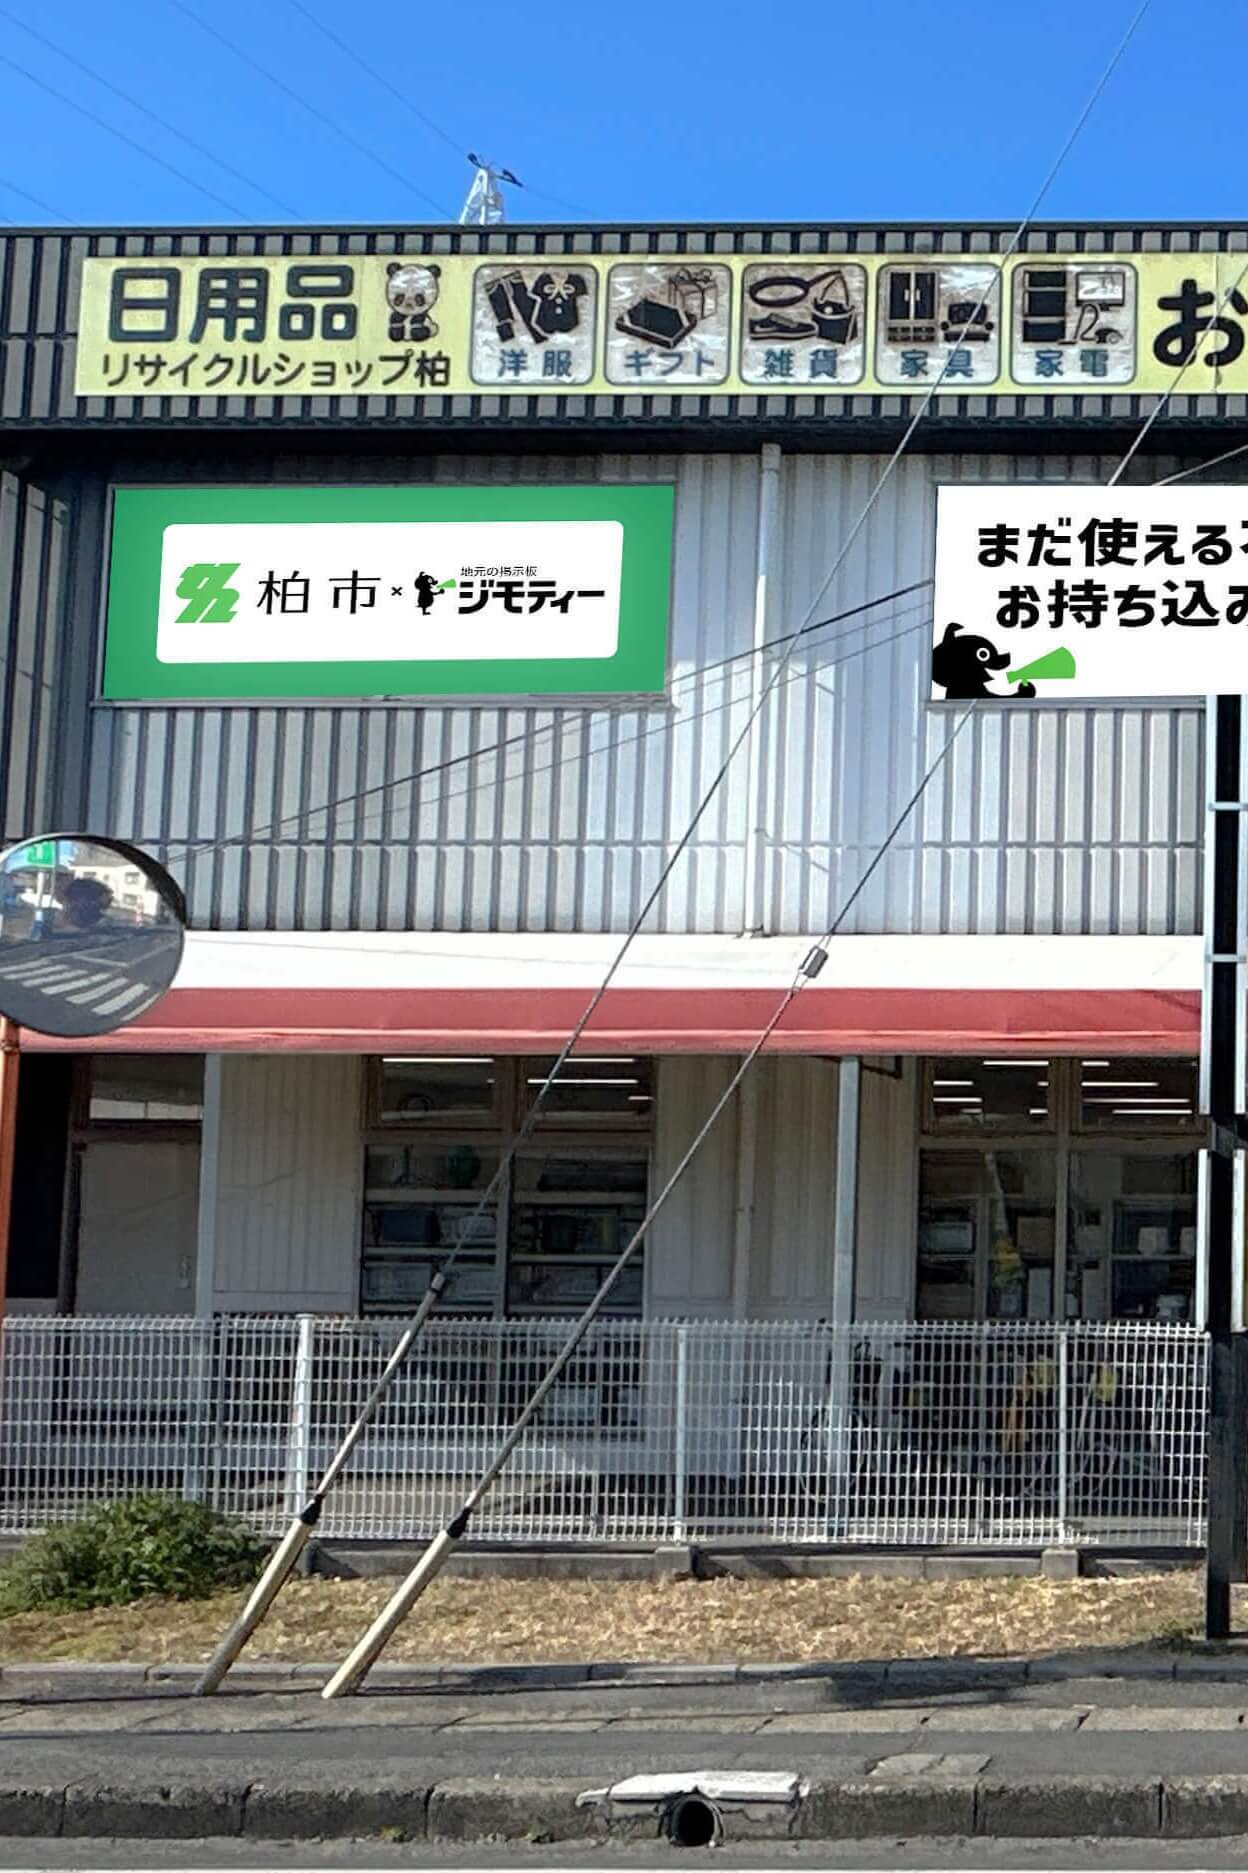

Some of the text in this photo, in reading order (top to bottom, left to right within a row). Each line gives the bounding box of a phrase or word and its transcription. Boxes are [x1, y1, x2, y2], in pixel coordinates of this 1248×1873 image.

[109, 266, 357, 343] 日用品
[101, 349, 450, 388] リサイクルショップ柏
[499, 348, 573, 378] 洋服
[624, 348, 715, 376] ギフト
[763, 347, 838, 379] 雑貨
[900, 348, 975, 379] 家具
[1035, 347, 1109, 378] 家電
[460, 565, 538, 577] 地元の掲示板
[257, 569, 382, 615] 柏市
[458, 580, 605, 614] ジモティー
